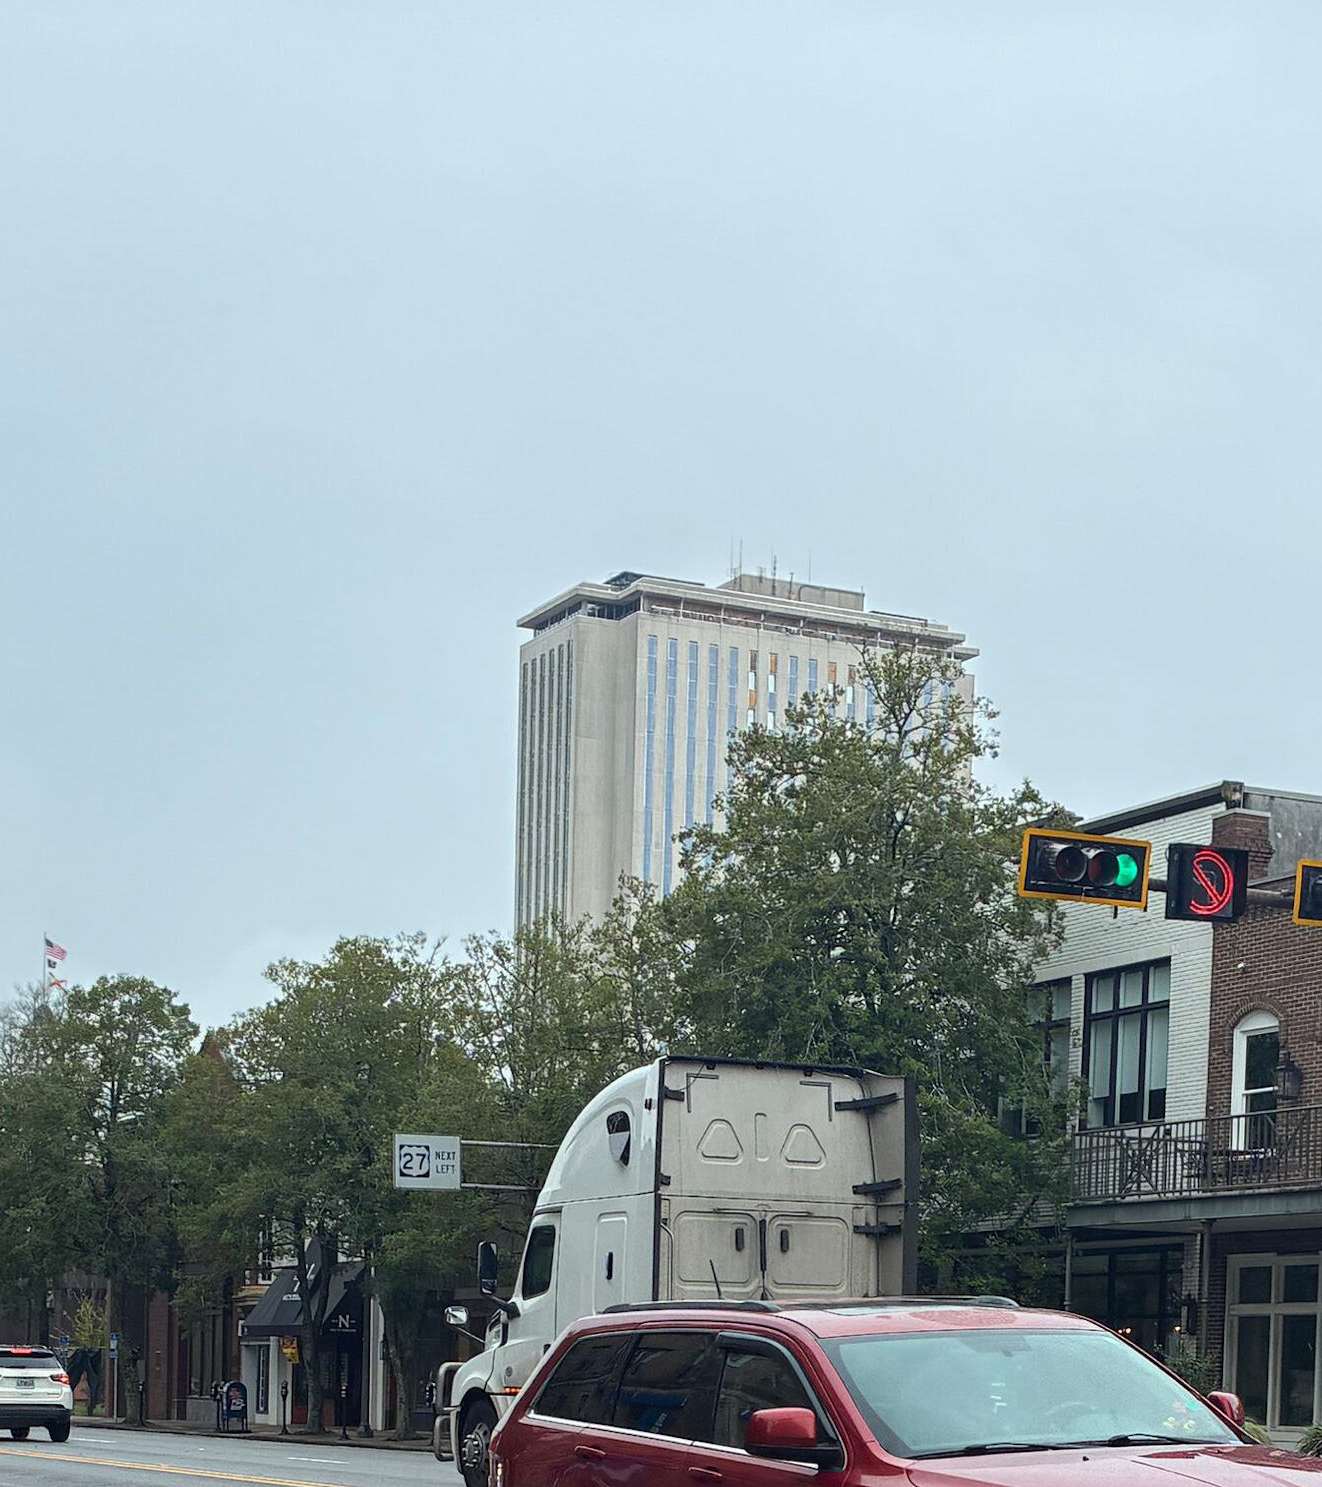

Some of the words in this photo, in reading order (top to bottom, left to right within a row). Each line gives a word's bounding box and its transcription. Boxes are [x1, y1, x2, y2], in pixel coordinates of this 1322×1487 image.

[402, 1152, 427, 1171] 27
[435, 1151, 456, 1160] NEXT
[435, 1164, 456, 1174] LEFT
[338, 1314, 350, 1328] N
